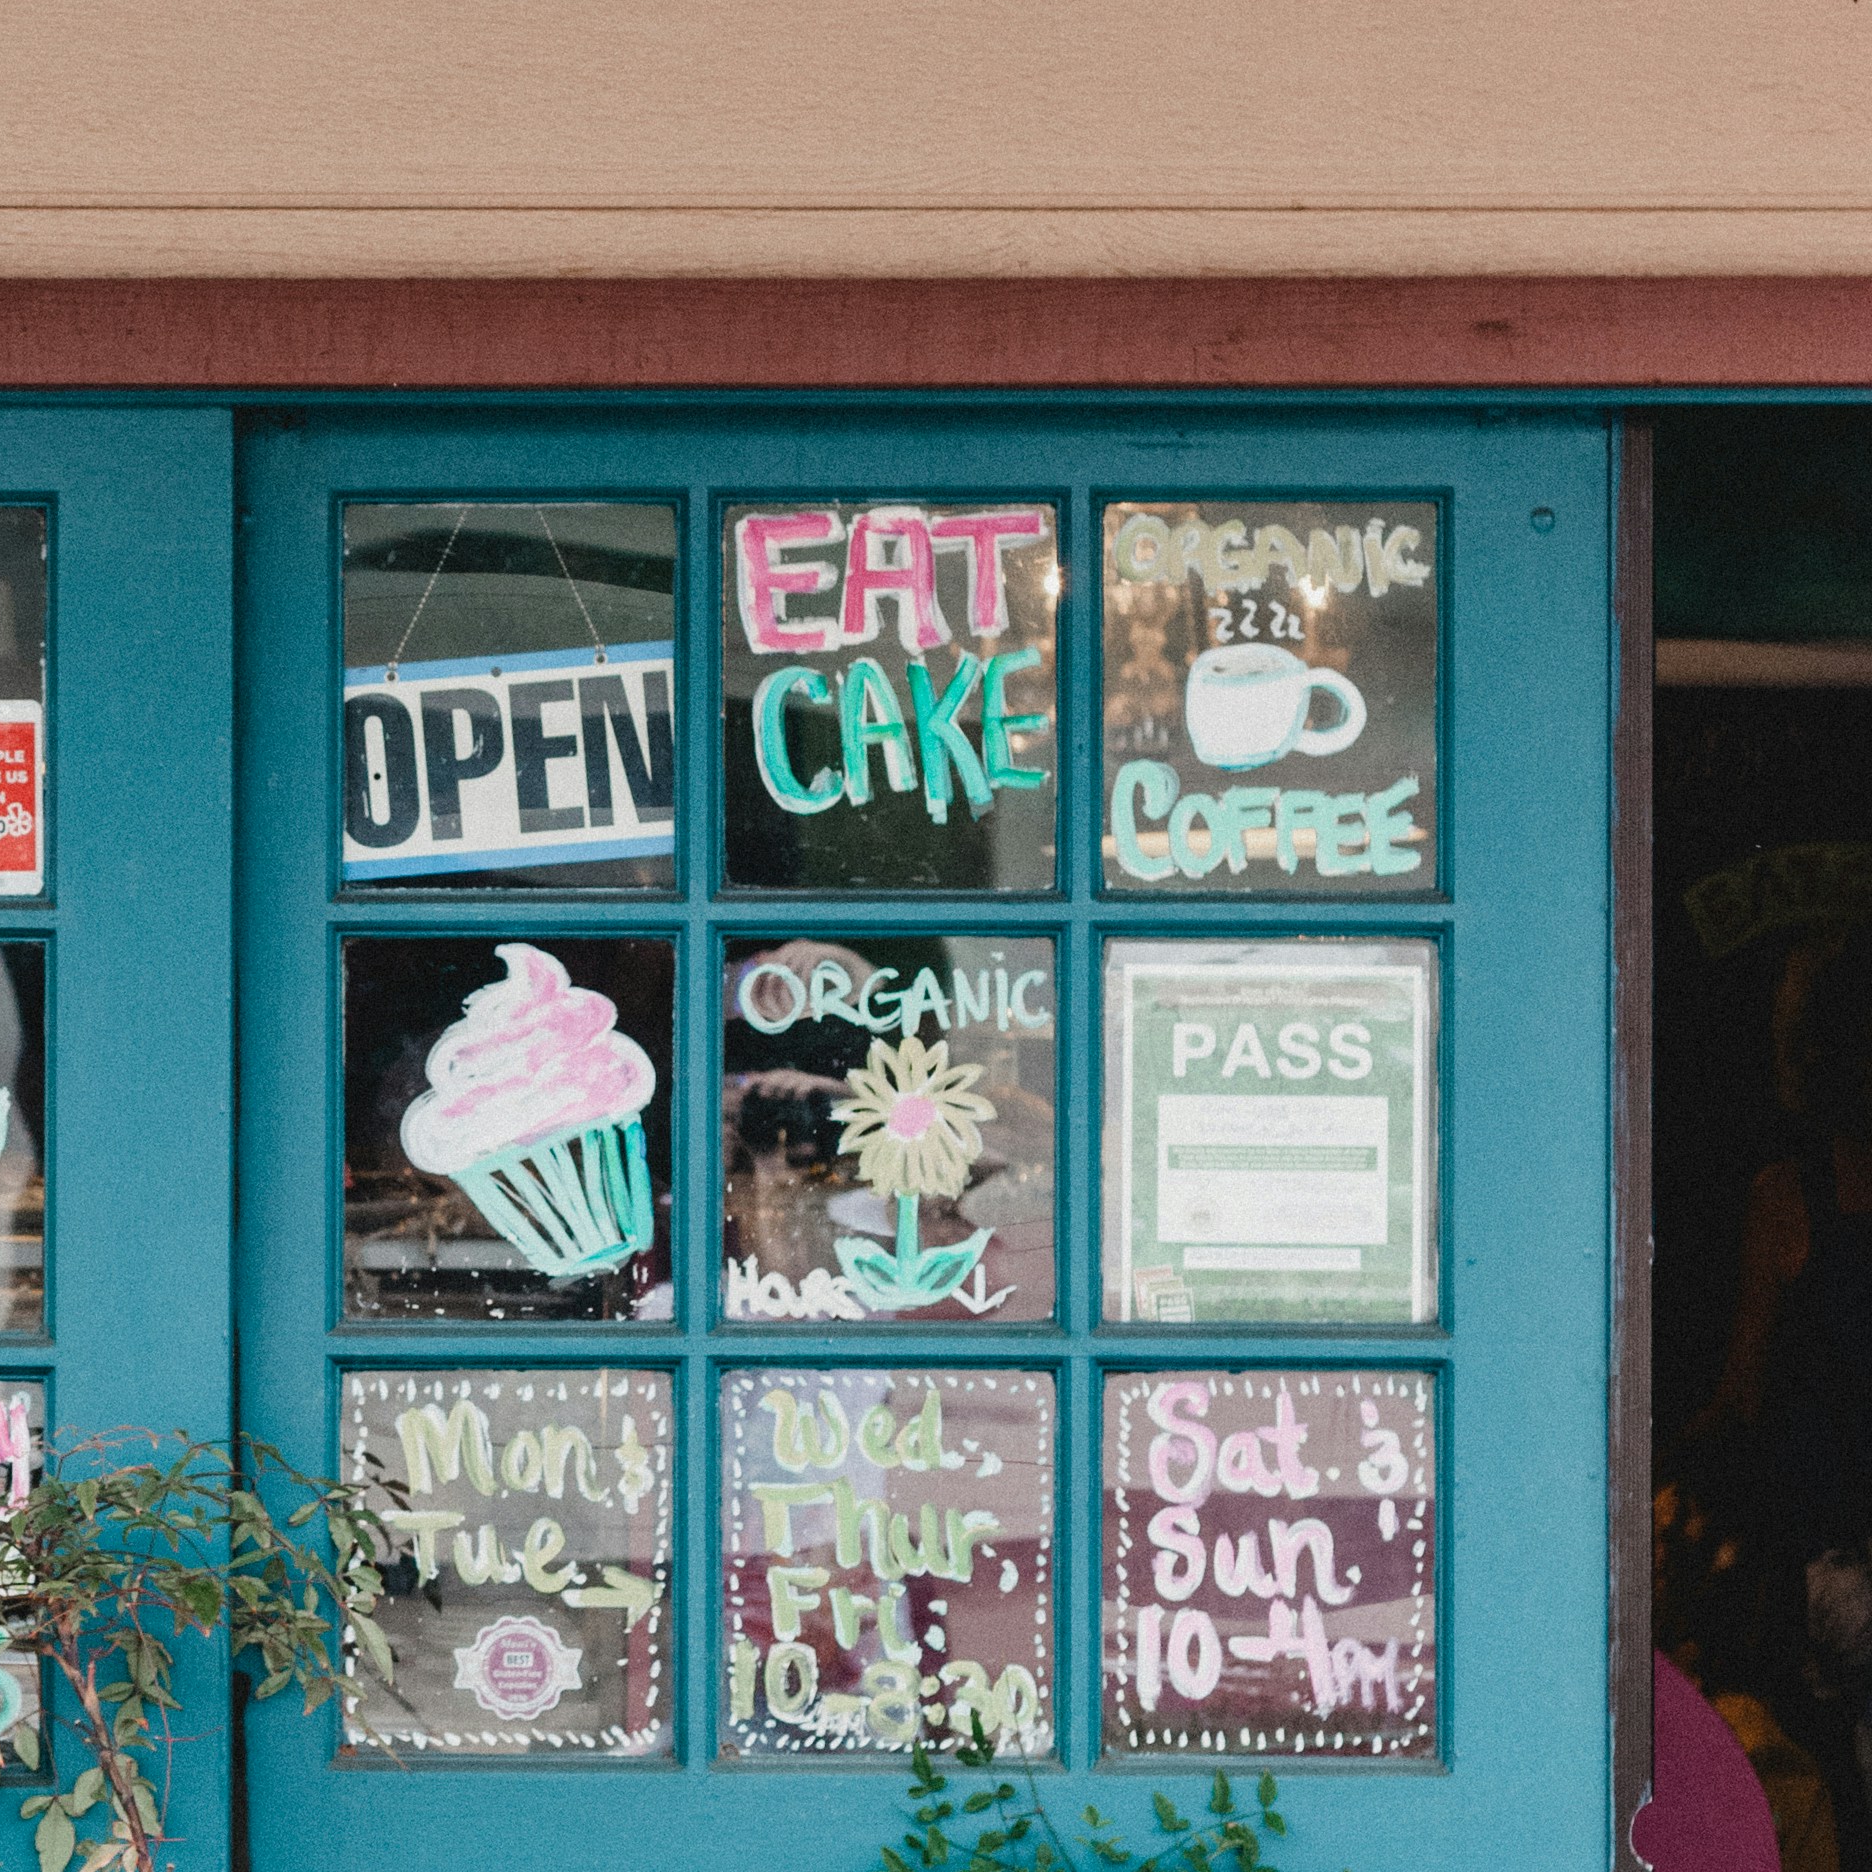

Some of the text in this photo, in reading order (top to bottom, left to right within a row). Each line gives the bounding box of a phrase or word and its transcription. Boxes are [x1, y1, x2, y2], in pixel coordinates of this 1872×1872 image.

[736, 506, 1051, 655] EAT
[5, 770, 29, 784] US
[345, 670, 674, 849] OPEN
[753, 646, 1051, 824] CAKE
[1110, 759, 1422, 880] COFFEE
[1173, 1023, 1373, 1081] PASS
